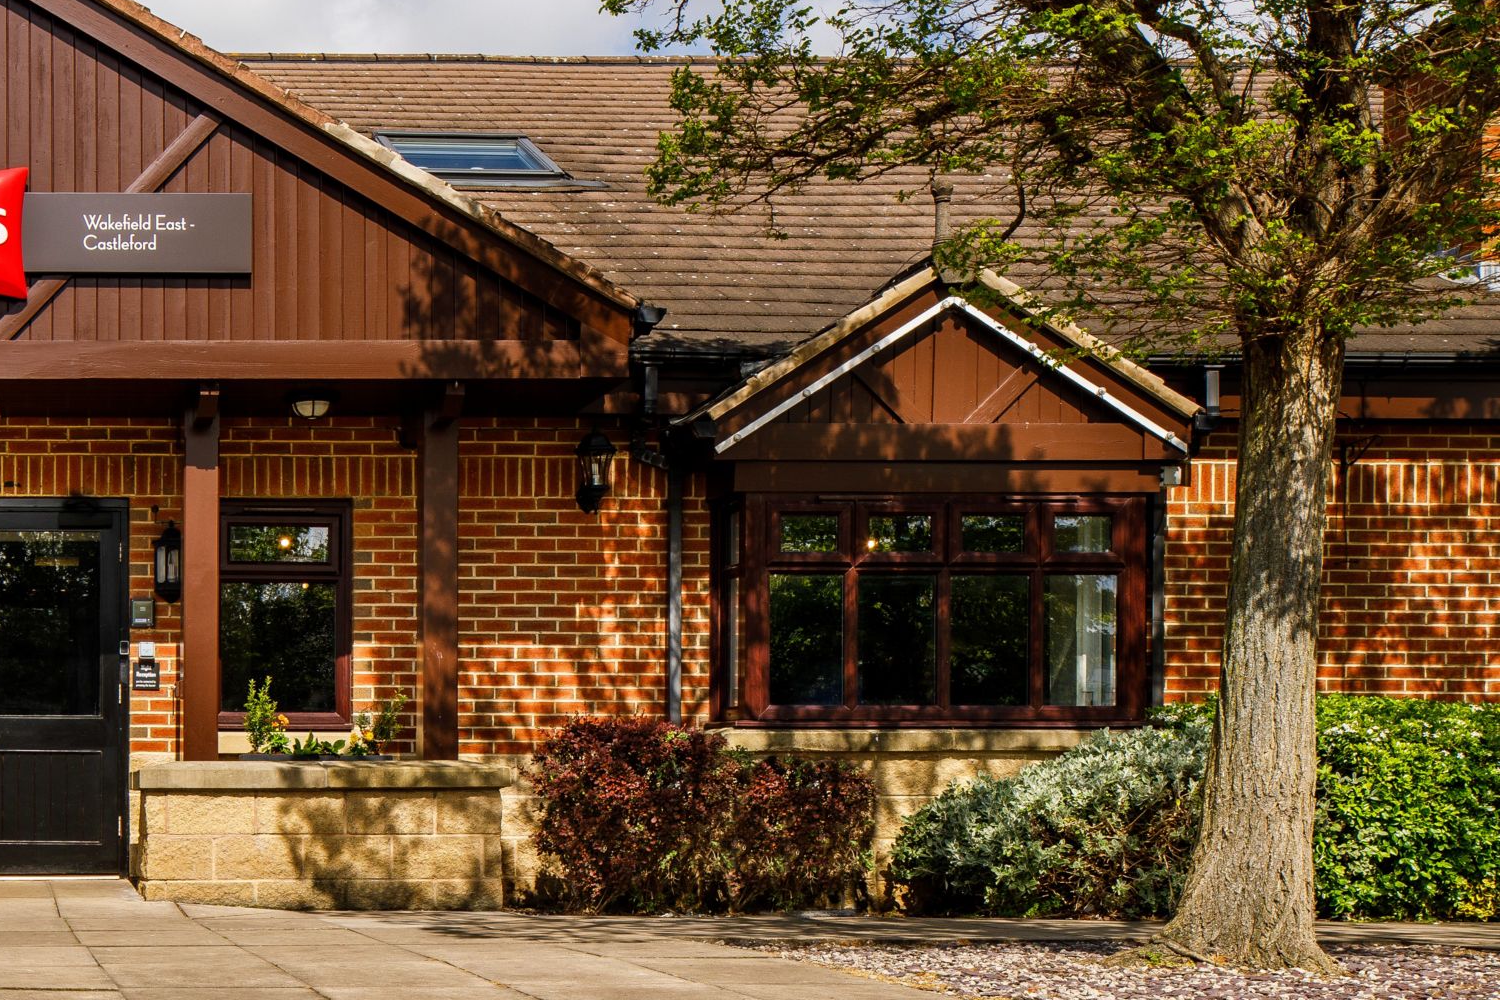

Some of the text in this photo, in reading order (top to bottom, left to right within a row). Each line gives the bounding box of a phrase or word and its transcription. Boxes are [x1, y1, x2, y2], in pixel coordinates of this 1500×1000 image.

[83, 214, 151, 230] Wakefield
[156, 214, 186, 230] East
[83, 234, 157, 250] Castleford
